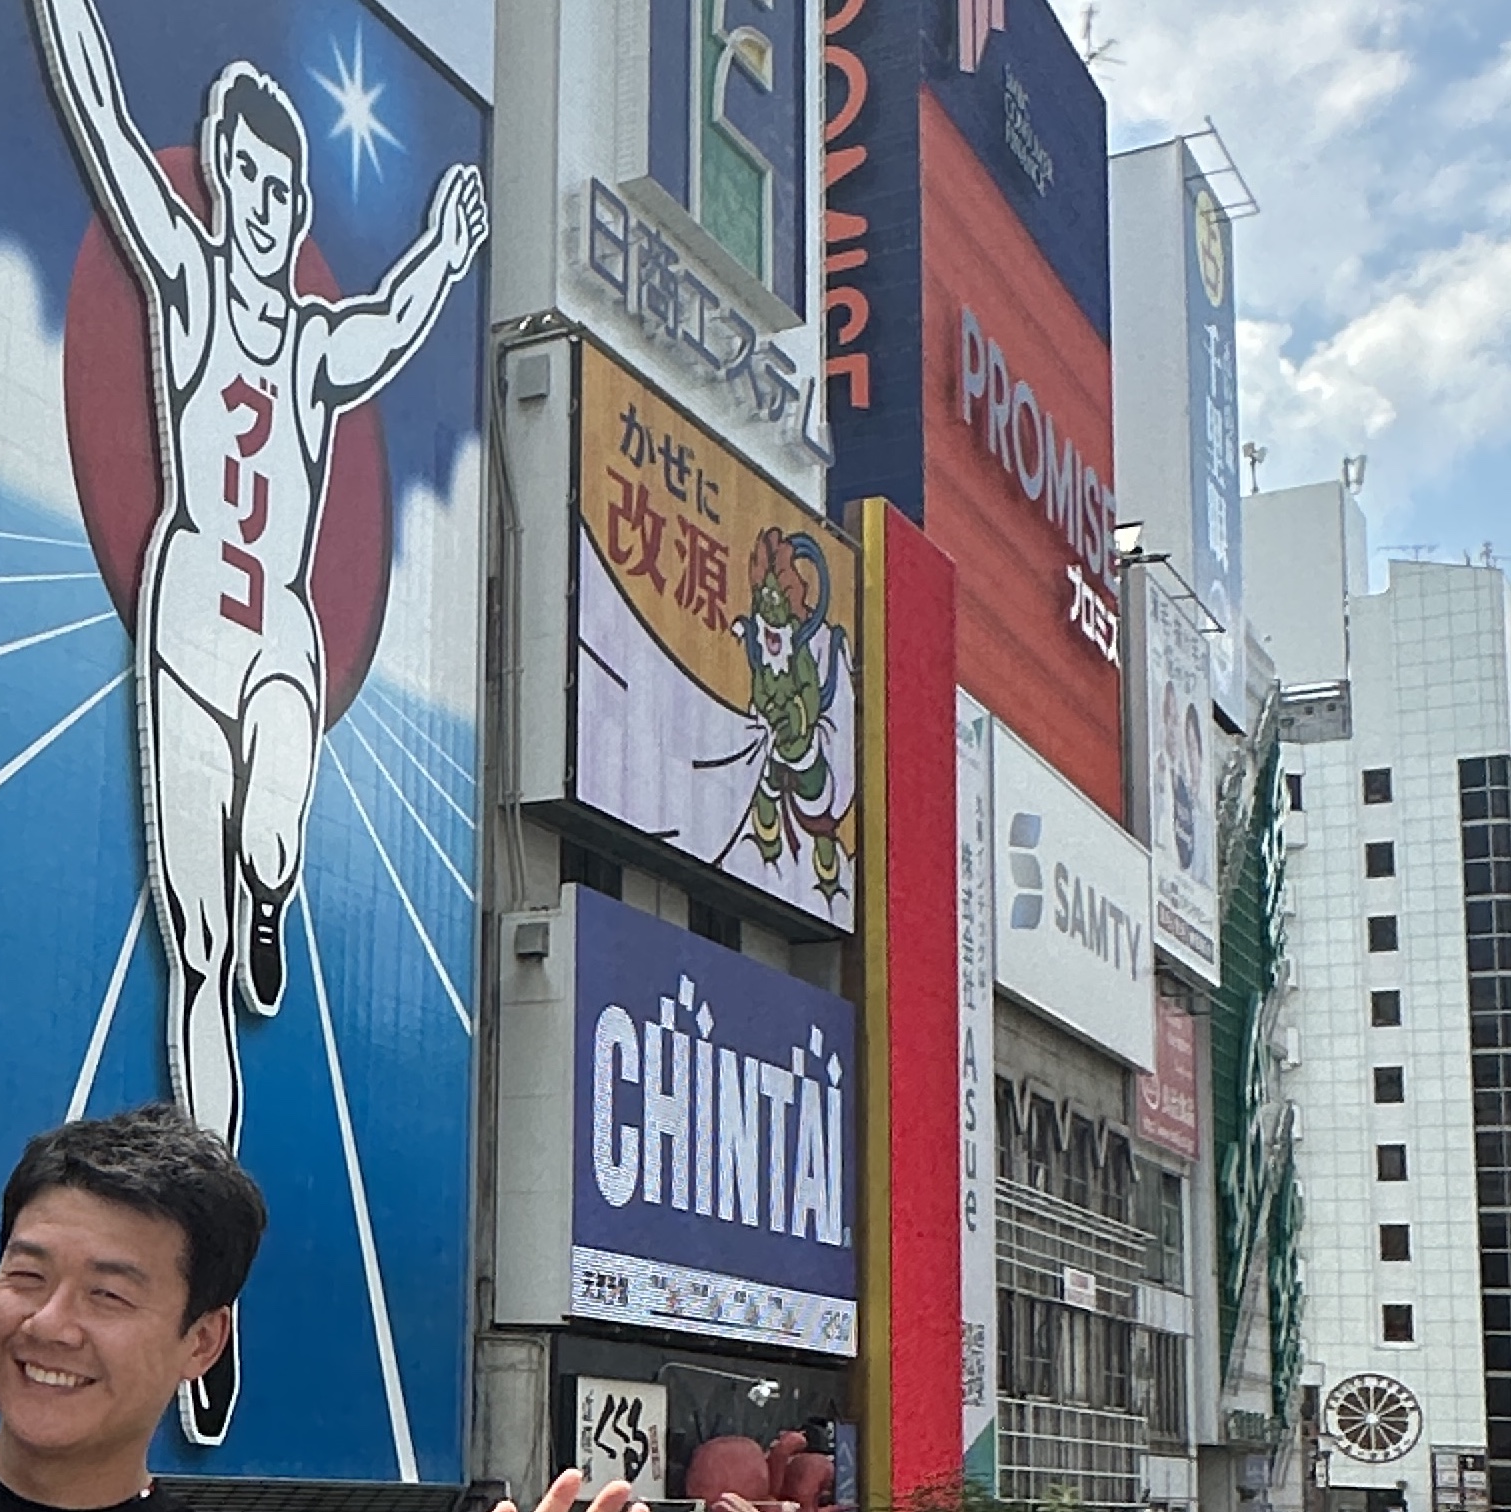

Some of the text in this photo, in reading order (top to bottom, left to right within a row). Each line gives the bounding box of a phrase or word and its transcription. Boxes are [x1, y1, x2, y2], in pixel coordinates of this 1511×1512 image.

[220, 373, 278, 636] グリコ
[605, 466, 732, 633] 改源
[619, 402, 721, 525] かぜに
[961, 303, 1119, 600] PROMISE
[1053, 861, 1142, 982] SAMTY
[593, 974, 843, 1246] CHINTAI
